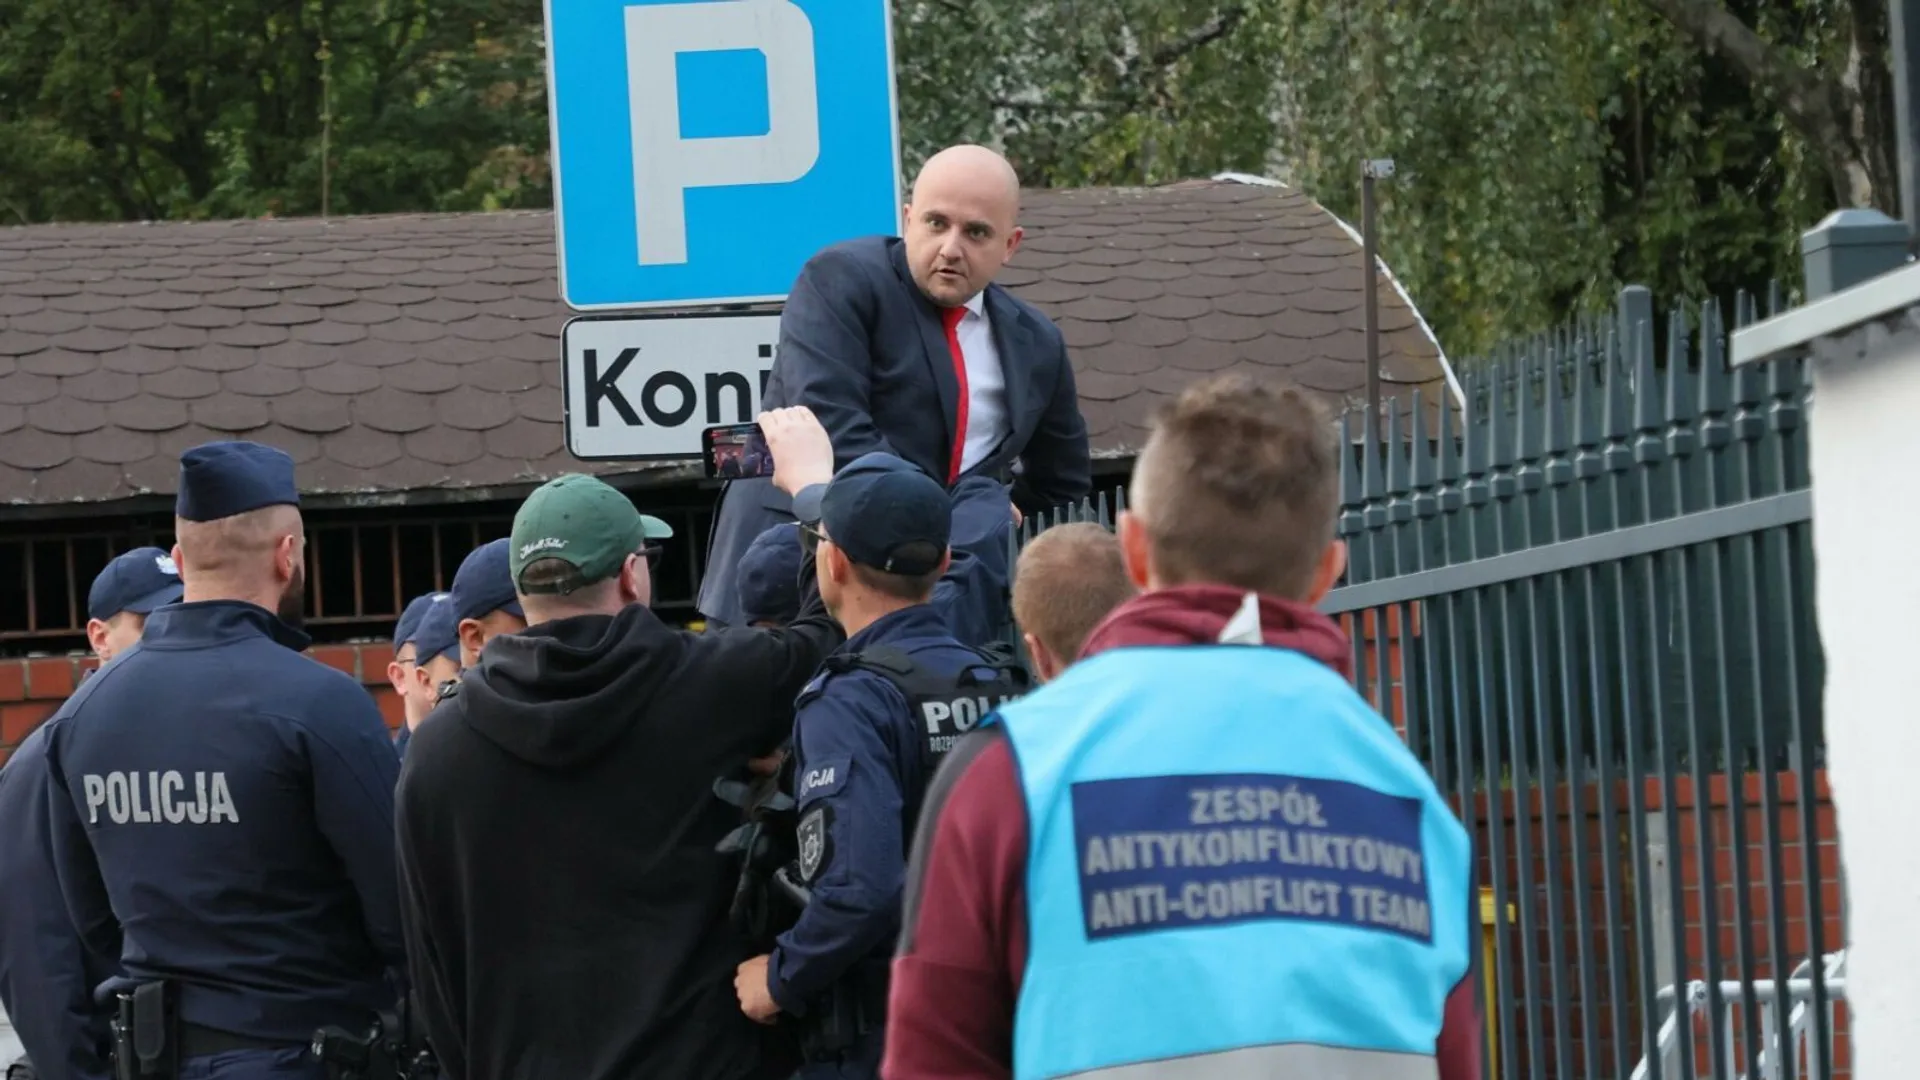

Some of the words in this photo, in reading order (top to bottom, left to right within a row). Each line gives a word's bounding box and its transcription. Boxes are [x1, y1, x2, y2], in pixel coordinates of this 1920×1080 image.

[624, 0, 820, 266] P
[83, 770, 239, 824] POLICJA
[1189, 785, 1327, 827] ZESPÓŁ
[1086, 828, 1422, 883] ANTYKONFLIKTOWY
[1091, 877, 1341, 931] ANTI-CONFLICT
[1348, 885, 1431, 936] TEAM
